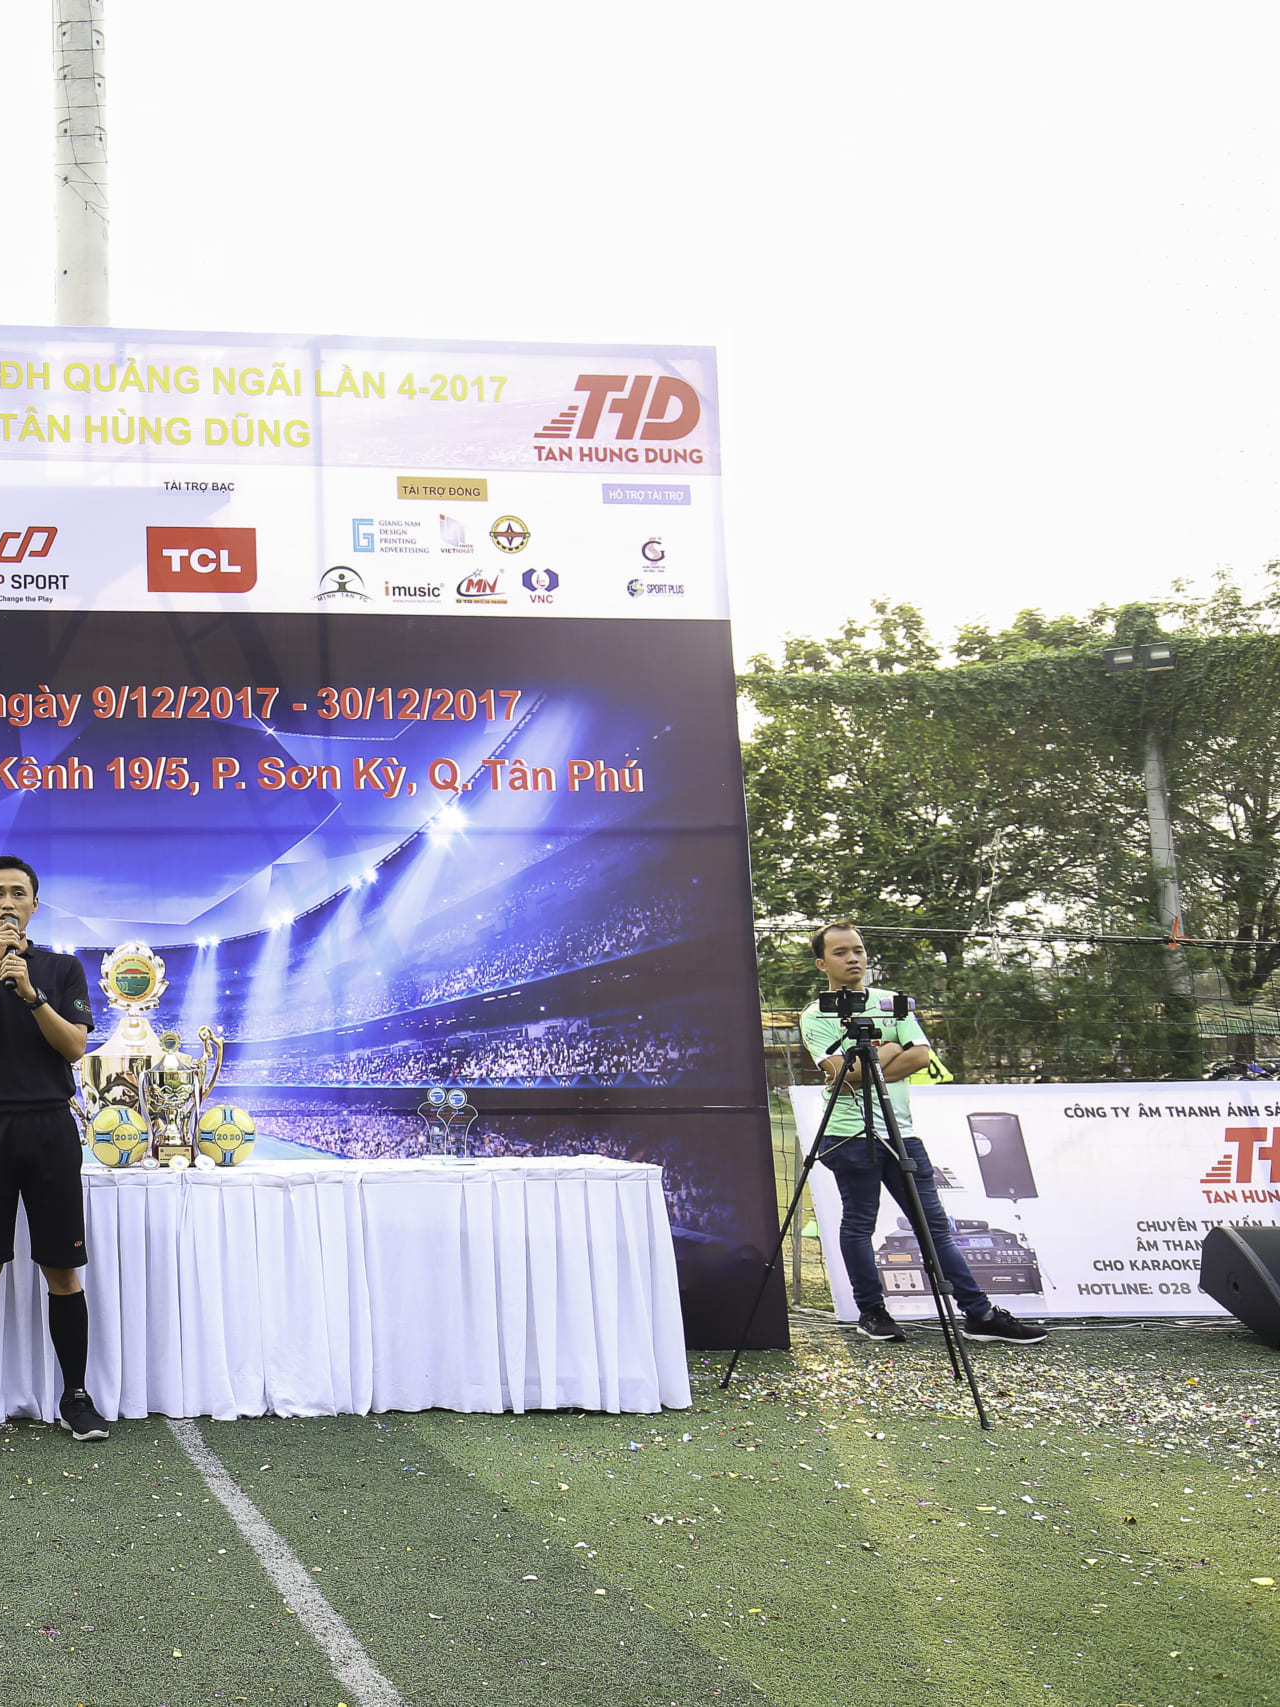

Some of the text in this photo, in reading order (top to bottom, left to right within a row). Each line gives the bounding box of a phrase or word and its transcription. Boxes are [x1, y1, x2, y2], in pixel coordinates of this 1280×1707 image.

[63, 357, 200, 394] QUẢNG
[213, 362, 301, 397] NGÃI
[398, 373, 508, 402] 4-2017
[85, 408, 191, 444] HÙNG
[205, 412, 310, 448] DŨNG
[534, 446, 703, 464] TAN HUNG DUNG
[164, 480, 235, 493] TÀI TRỢ BẠC
[402, 484, 419, 495] TÀI
[422, 487, 445, 497] TRỢ
[625, 490, 645, 502] TRỢ
[647, 489, 662, 500] TÀI
[664, 491, 684, 503] TRỢ
[162, 547, 242, 573] TCL
[11, 574, 69, 590] SPORT
[647, 584, 685, 594] SPORT PLUS
[38, 596, 54, 604] Play
[529, 594, 554, 604] VNC
[92, 686, 280, 719] 9/12/2017
[317, 687, 523, 722] 30/12/2017
[107, 757, 201, 796] 19/5,
[211, 757, 246, 790] P.
[258, 757, 341, 791] Sơn
[353, 756, 418, 798] Kỳ,
[429, 758, 473, 793] Q.
[487, 758, 557, 792] Tân
[568, 758, 644, 793] Phú
[1064, 1103, 1107, 1118] CÔNG
[1111, 1107, 1130, 1118] TY
[1138, 1103, 1162, 1118] ÂM
[1165, 1106, 1221, 1118] THANH
[1202, 1190, 1238, 1204] TAN
[1136, 1217, 1197, 1232] CHUYÊN
[1136, 1236, 1203, 1251] ÂM THAN
[1093, 1259, 1201, 1271] CHO KARAOKE
[1077, 1283, 1153, 1295] HOTLINE:
[1158, 1282, 1192, 1295] 028
